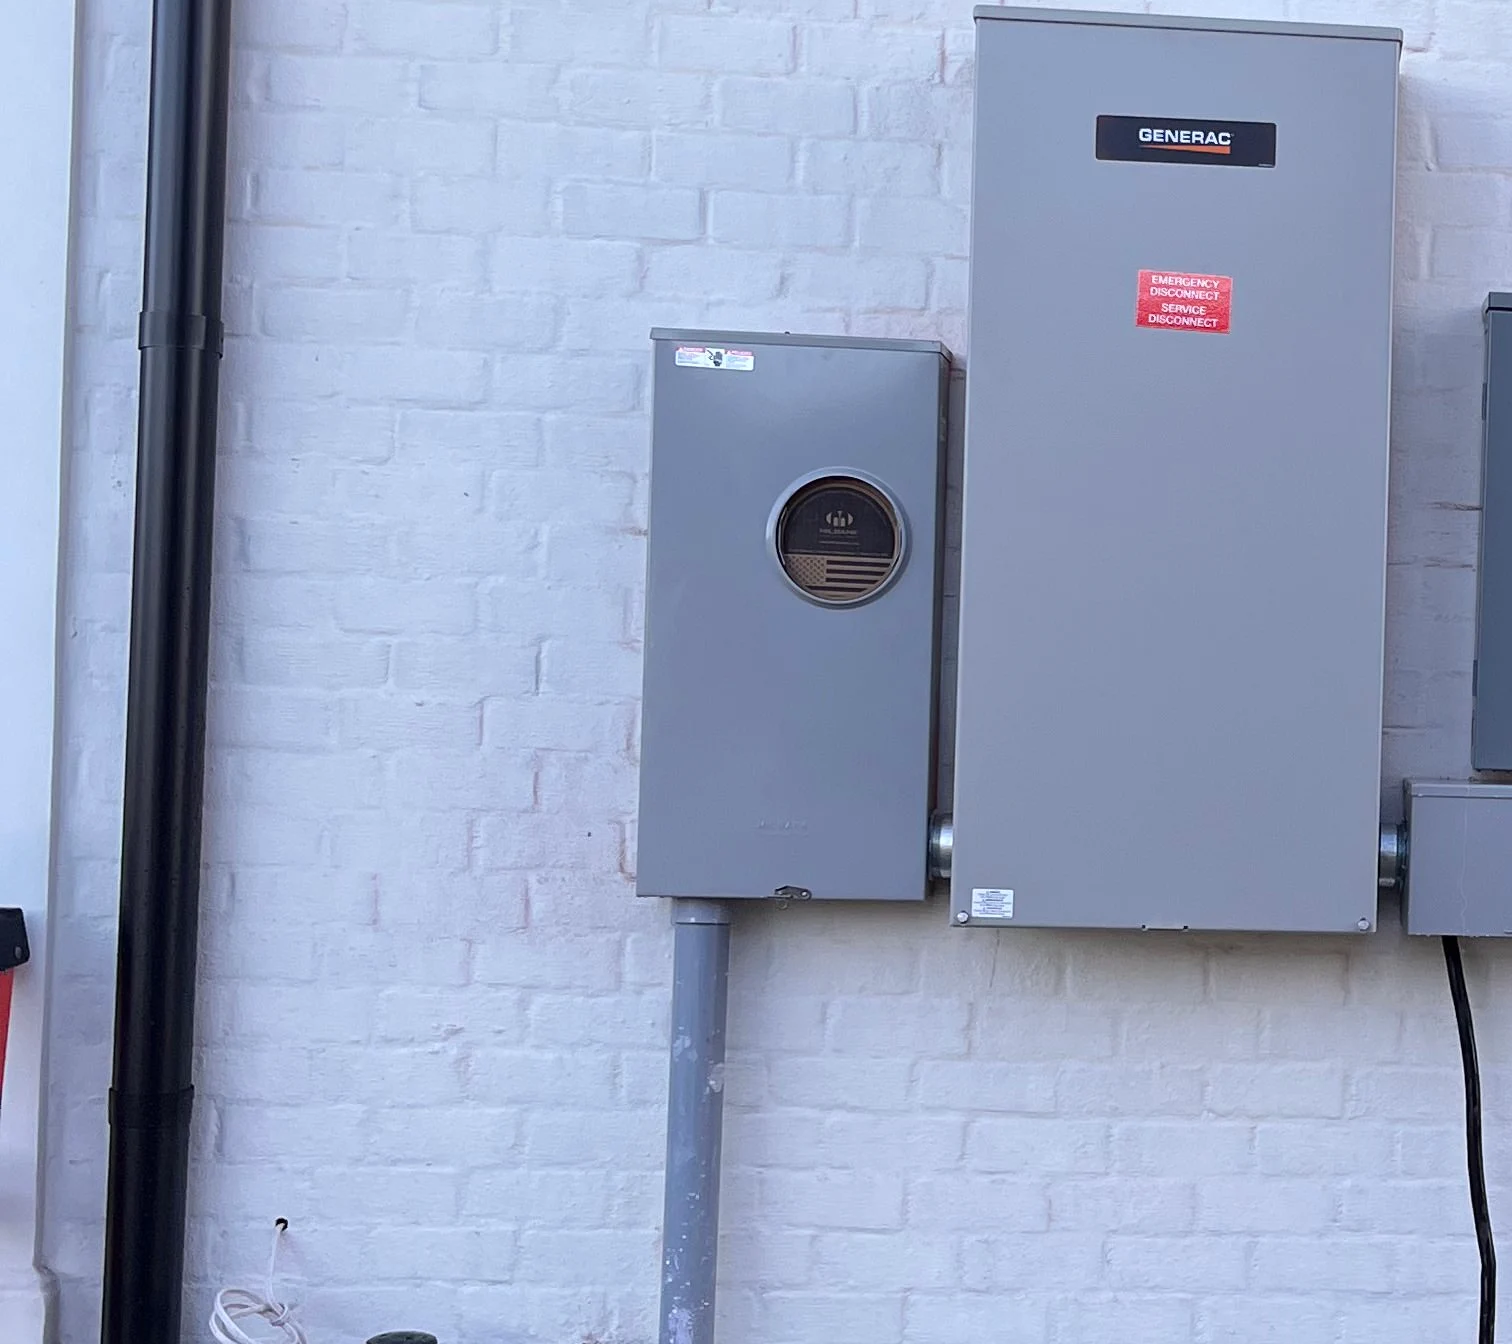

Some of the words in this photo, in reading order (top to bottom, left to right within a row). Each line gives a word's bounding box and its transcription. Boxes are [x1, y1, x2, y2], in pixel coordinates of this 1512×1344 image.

[1139, 128, 1231, 146] GENERAC
[1151, 275, 1219, 289] EMERGENCY
[1149, 287, 1220, 301] DISCONNECT
[1161, 302, 1207, 316] SERVICE
[1148, 313, 1219, 328] DISCONNECT
